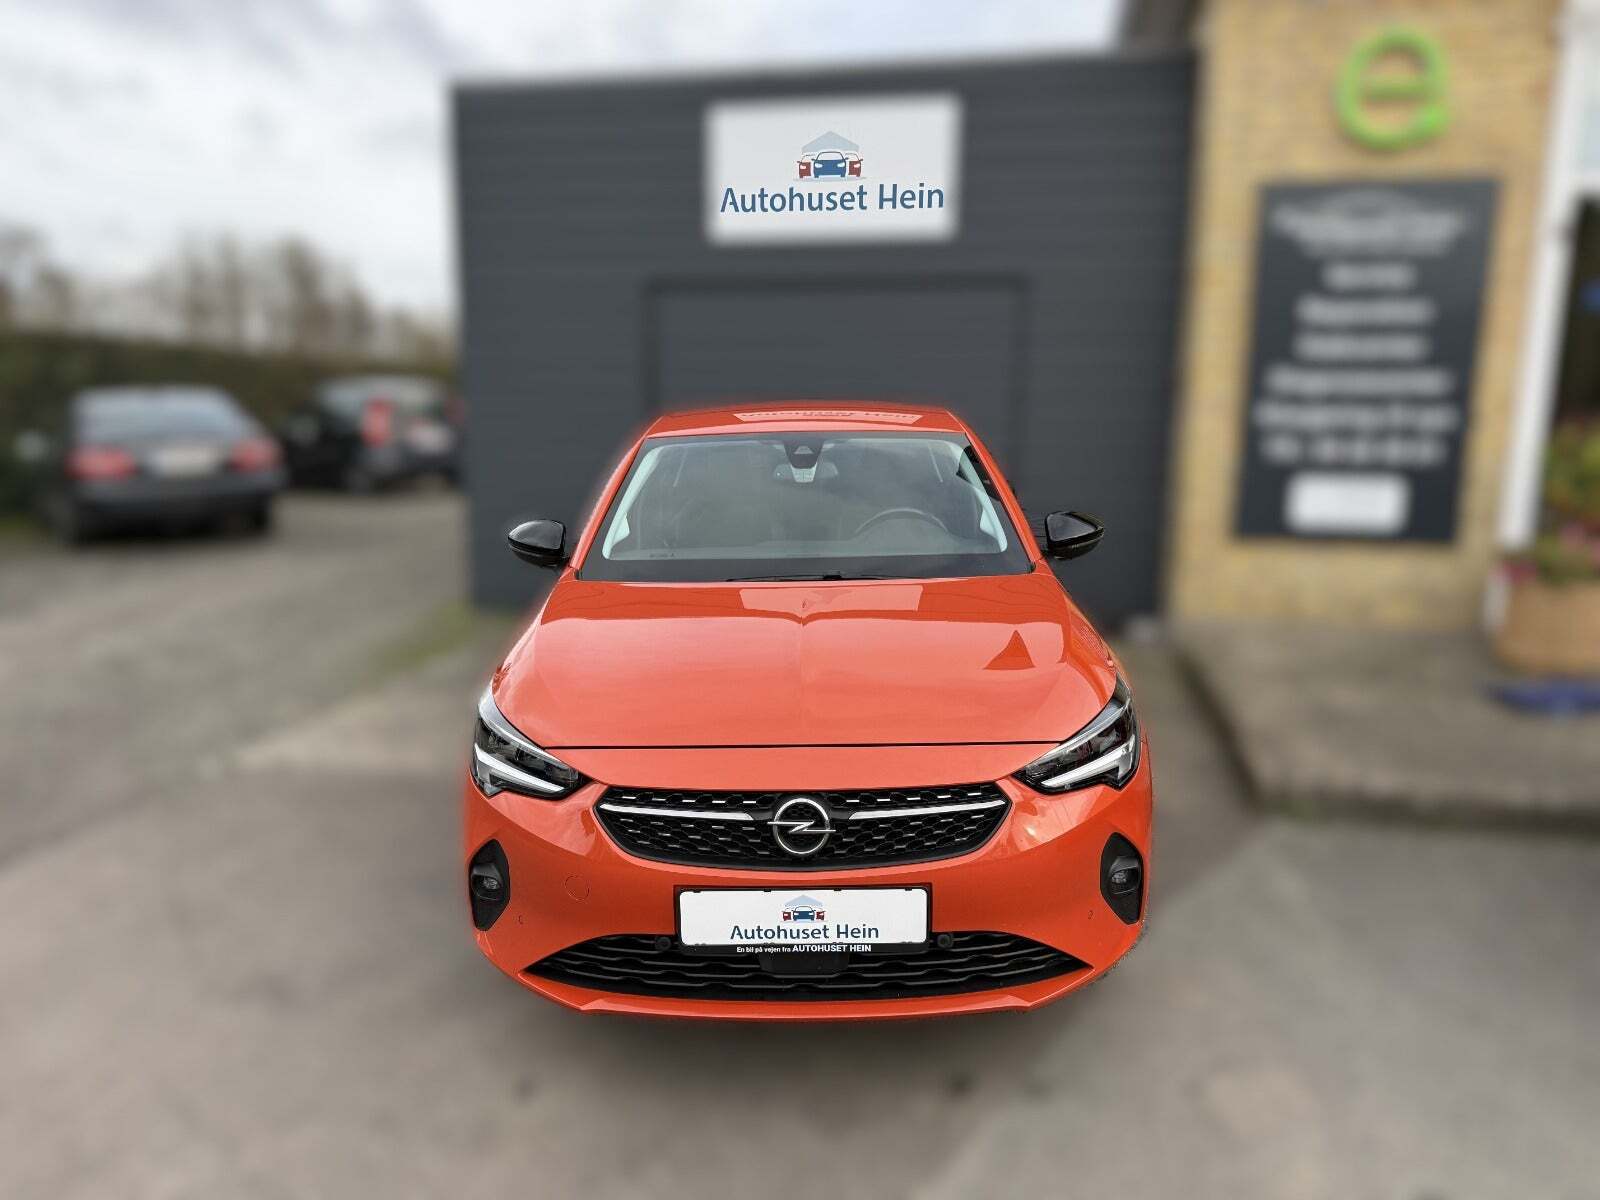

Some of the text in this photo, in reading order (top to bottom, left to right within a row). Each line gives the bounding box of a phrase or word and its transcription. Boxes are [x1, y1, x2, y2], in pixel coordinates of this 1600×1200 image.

[1337, 27, 1448, 149] e
[720, 182, 944, 212] Autohuset Hein
[730, 923, 879, 940] Autohuset Hein
[792, 944, 848, 952] AUTOHUSET
[850, 944, 872, 952] HEIN
